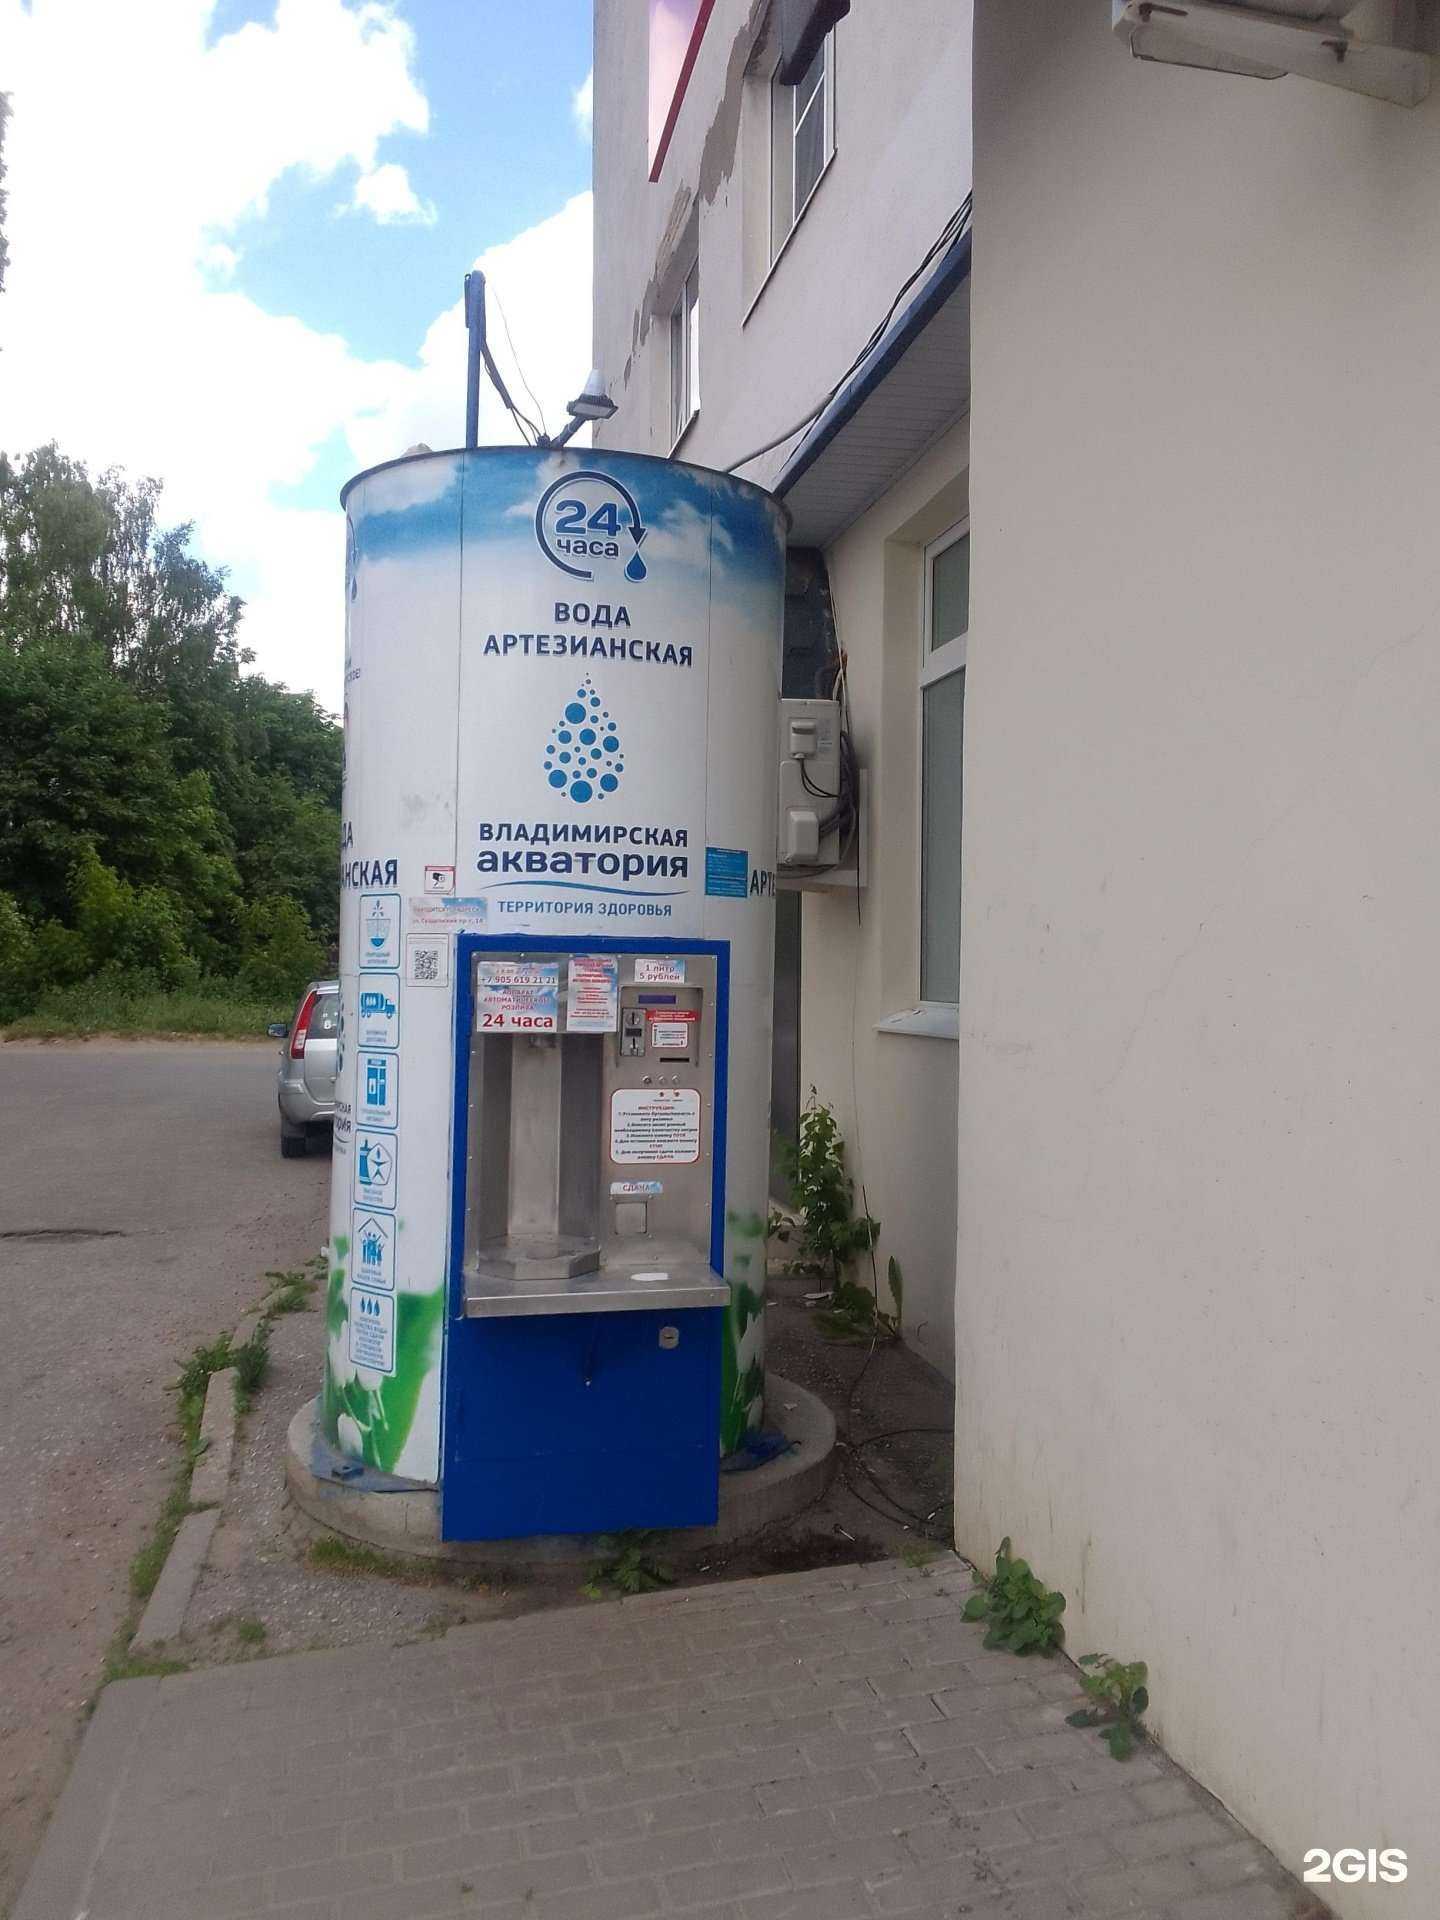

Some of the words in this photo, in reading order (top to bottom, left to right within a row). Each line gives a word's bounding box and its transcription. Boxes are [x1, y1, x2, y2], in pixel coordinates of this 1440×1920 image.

[554, 498, 621, 537] 24
[556, 538, 619, 557] часа
[555, 602, 631, 628] ВОДА
[483, 634, 693, 667] АРТЕЗИАНСКАЯ
[480, 823, 688, 847] ВЛАДИМИРСКАЯ
[477, 849, 689, 881] акватория
[497, 901, 594, 914] ТЕРРИТОРИЯ
[598, 903, 672, 916] ЗДОРОВЬЯ
[495, 976, 510, 984] 905
[514, 976, 530, 984] 619
[483, 1013, 505, 1028] 24
[511, 1016, 554, 1028] часа
